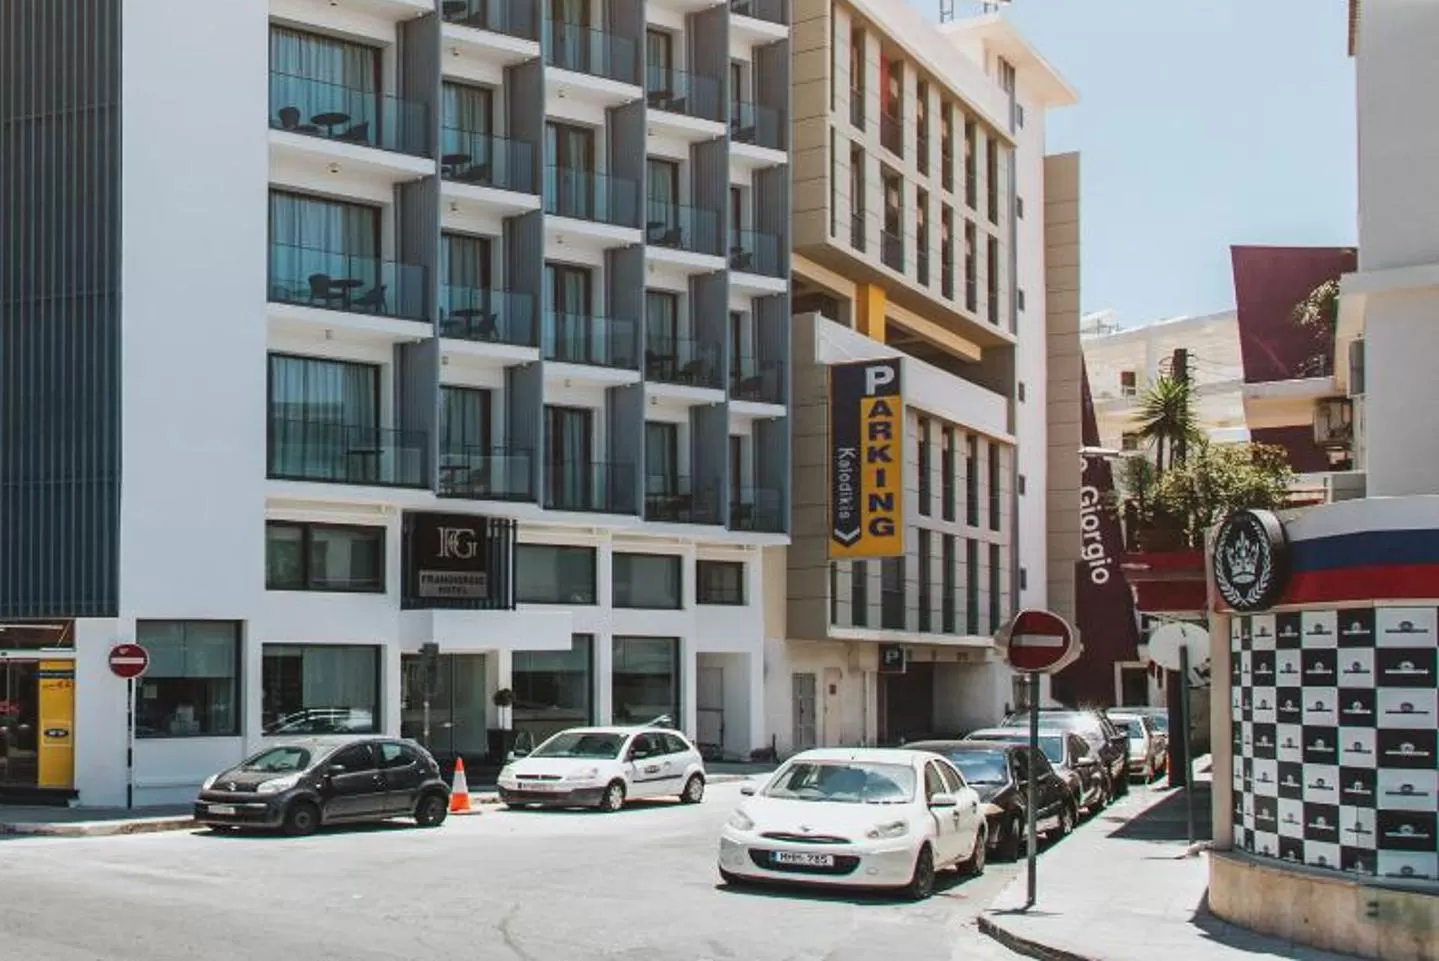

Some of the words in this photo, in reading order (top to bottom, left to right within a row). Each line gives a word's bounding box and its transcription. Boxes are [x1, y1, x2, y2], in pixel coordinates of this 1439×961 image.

[864, 365, 895, 537] PARKING
[1080, 485, 1112, 584] Giorgio
[885, 650, 899, 665] P
